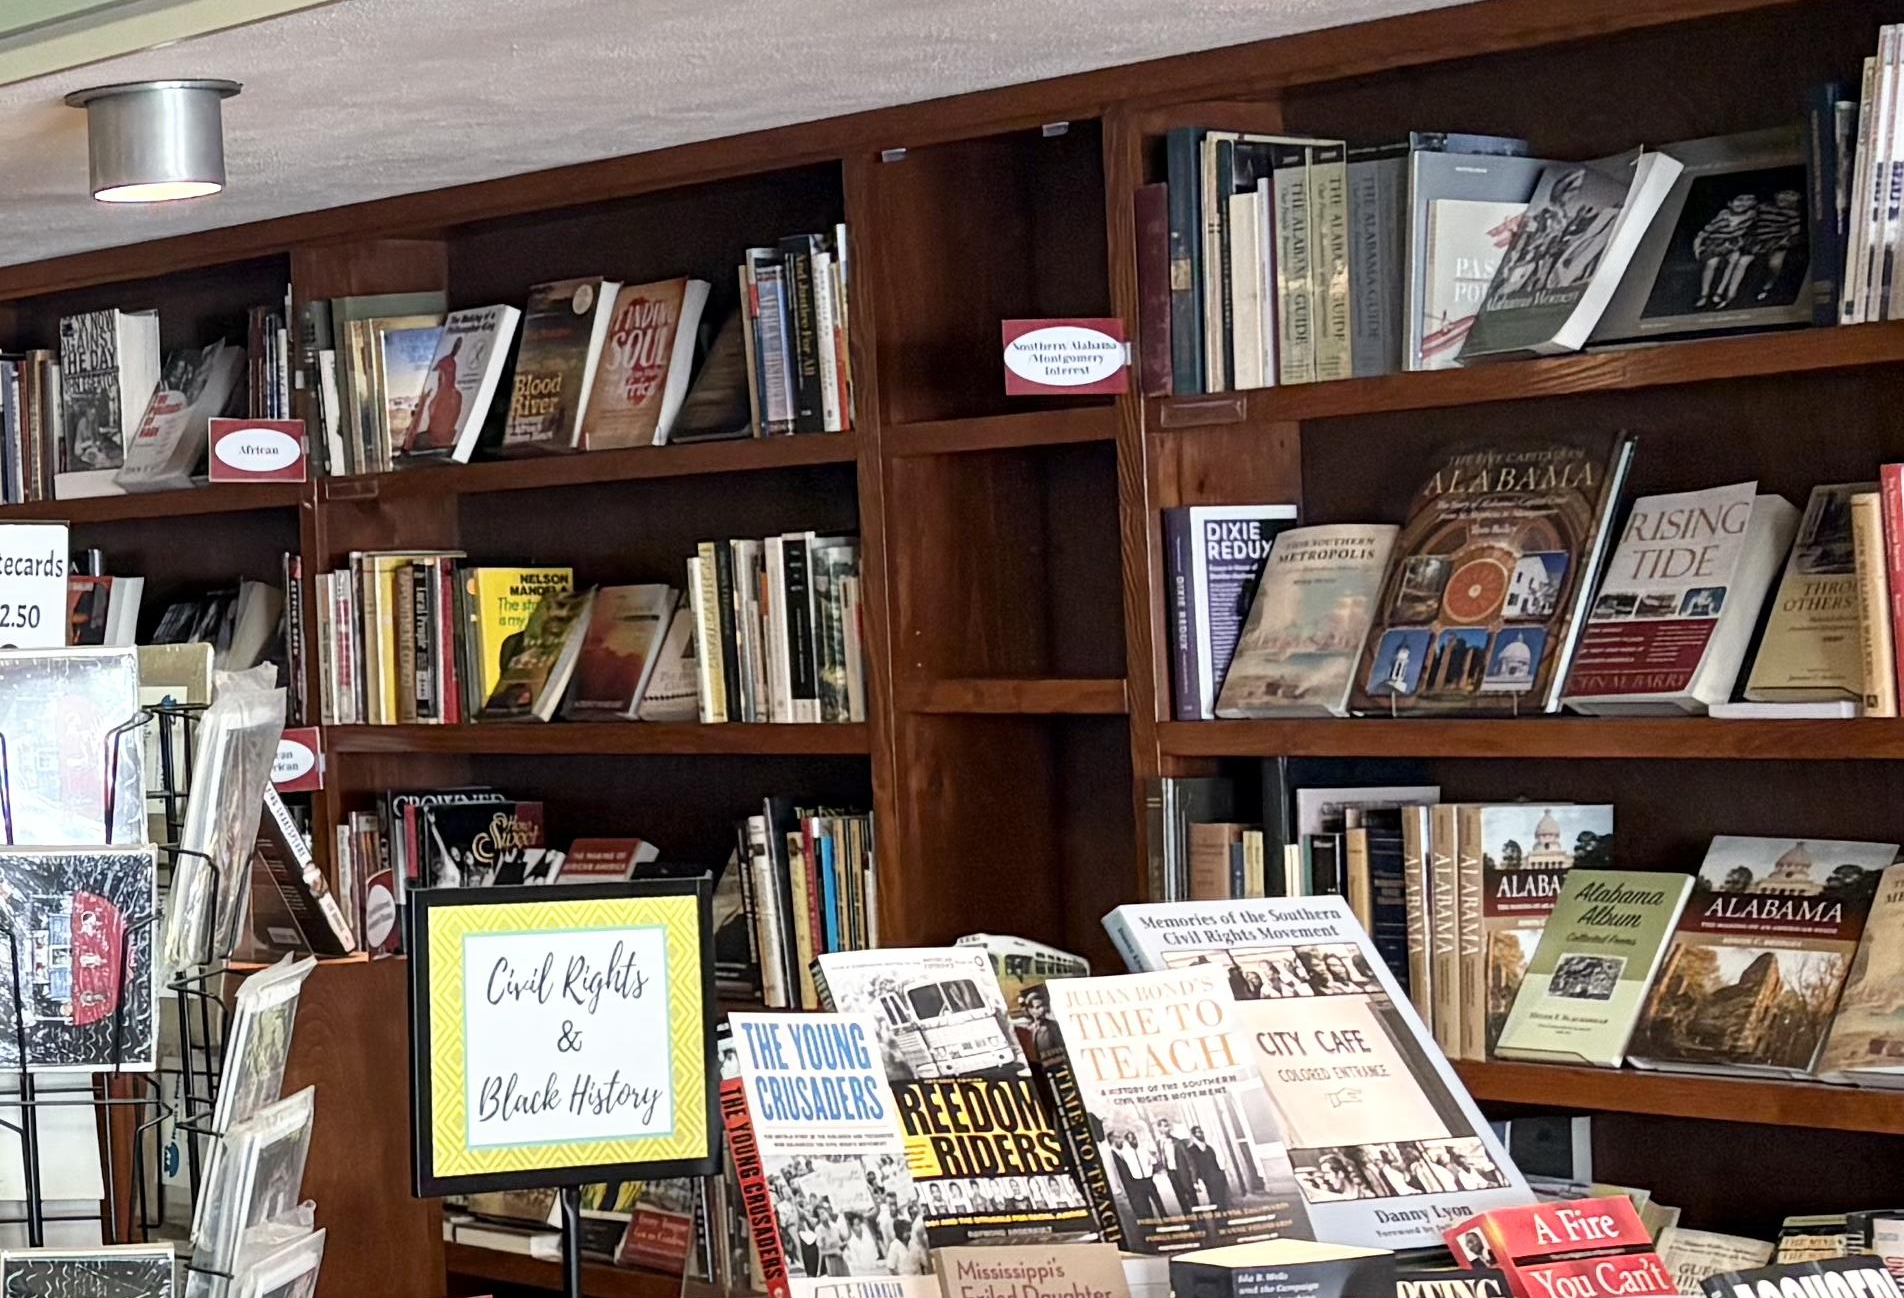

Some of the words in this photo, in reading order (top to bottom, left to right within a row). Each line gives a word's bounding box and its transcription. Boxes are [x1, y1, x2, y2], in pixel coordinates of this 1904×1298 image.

[604, 327, 669, 371] SOUL
[514, 372, 562, 395] Blood
[1044, 365, 1090, 377] Interest
[510, 393, 560, 419] River
[239, 444, 280, 457] African
[1423, 460, 1593, 497] ALABAMA
[1206, 522, 1261, 541] DIXIE
[1624, 502, 1750, 543] RISING
[1208, 541, 1273, 560] REDUX
[1278, 548, 1376, 564] METROPOLIS
[1632, 545, 1720, 580] TIDE
[519, 574, 569, 585] NELSON
[1573, 881, 1665, 906] Alabama
[1139, 912, 1213, 931] Memories
[1216, 910, 1236, 927] of
[1240, 909, 1263, 924] the
[1268, 906, 1342, 922] Southern
[1577, 905, 1642, 929] Album
[1704, 897, 1843, 924] ALABAMA
[1162, 929, 1201, 947] Civil
[1205, 927, 1256, 947] Rights
[1260, 923, 1340, 942] Movement
[486, 951, 554, 1006] Civil
[562, 940, 650, 1015] Rights
[557, 1020, 583, 1052] &
[741, 1022, 790, 1072] THE
[791, 1021, 872, 1071] YOUNG
[1256, 1030, 1311, 1058] CITY
[1317, 1028, 1372, 1054] CAFE
[1277, 1066, 1332, 1083] COLORED
[1334, 1063, 1392, 1080] ENTRANCE
[478, 1072, 562, 1123] Black
[569, 1069, 663, 1126] History
[755, 1074, 884, 1122] CRUSADERS
[934, 1134, 1064, 1178] RIDERS
[957, 1257, 1066, 1282] Mississippi's
